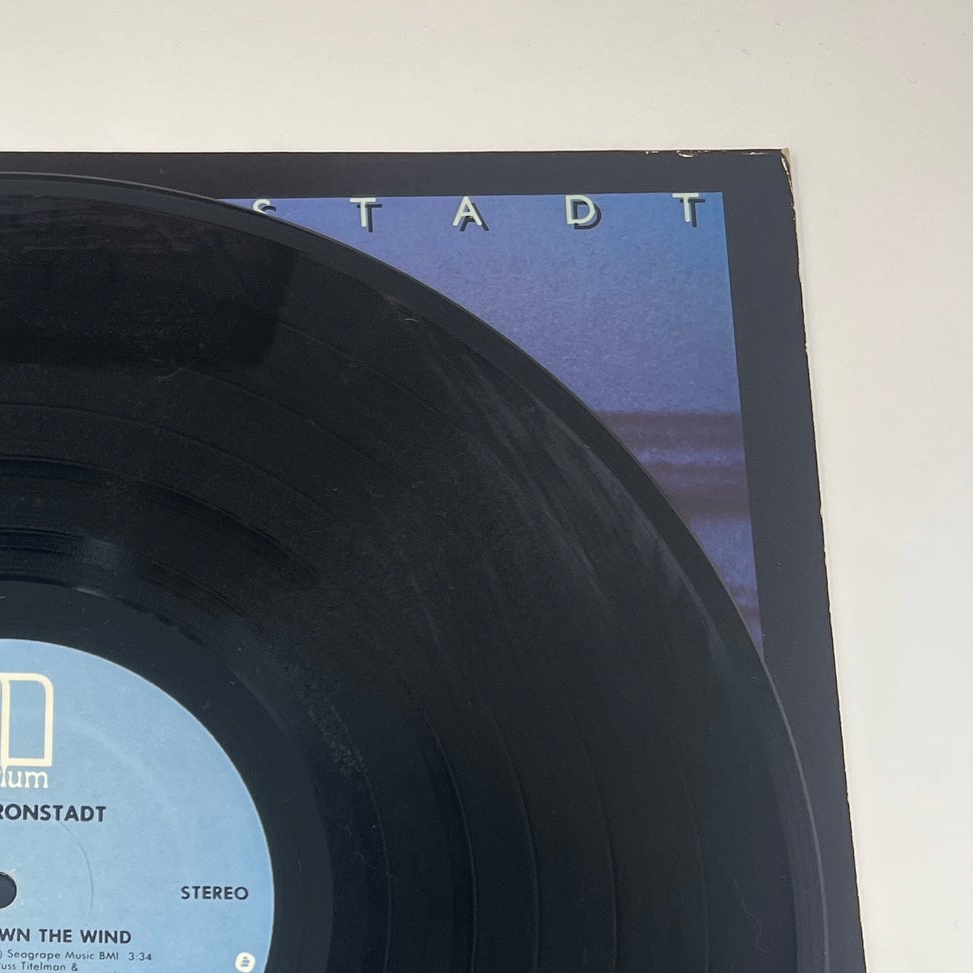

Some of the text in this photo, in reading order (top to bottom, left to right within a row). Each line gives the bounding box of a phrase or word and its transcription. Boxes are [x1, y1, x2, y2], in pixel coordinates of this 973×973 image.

[180, 885, 249, 901] STEREO
[38, 928, 73, 943] THE
[80, 929, 132, 944] WIND
[7, 949, 61, 961] Seagrape
[65, 951, 94, 960] Music
[99, 952, 119, 960] BMI
[128, 952, 152, 961] 3:34
[21, 961, 66, 971] Titelman
[71, 963, 78, 971] &
